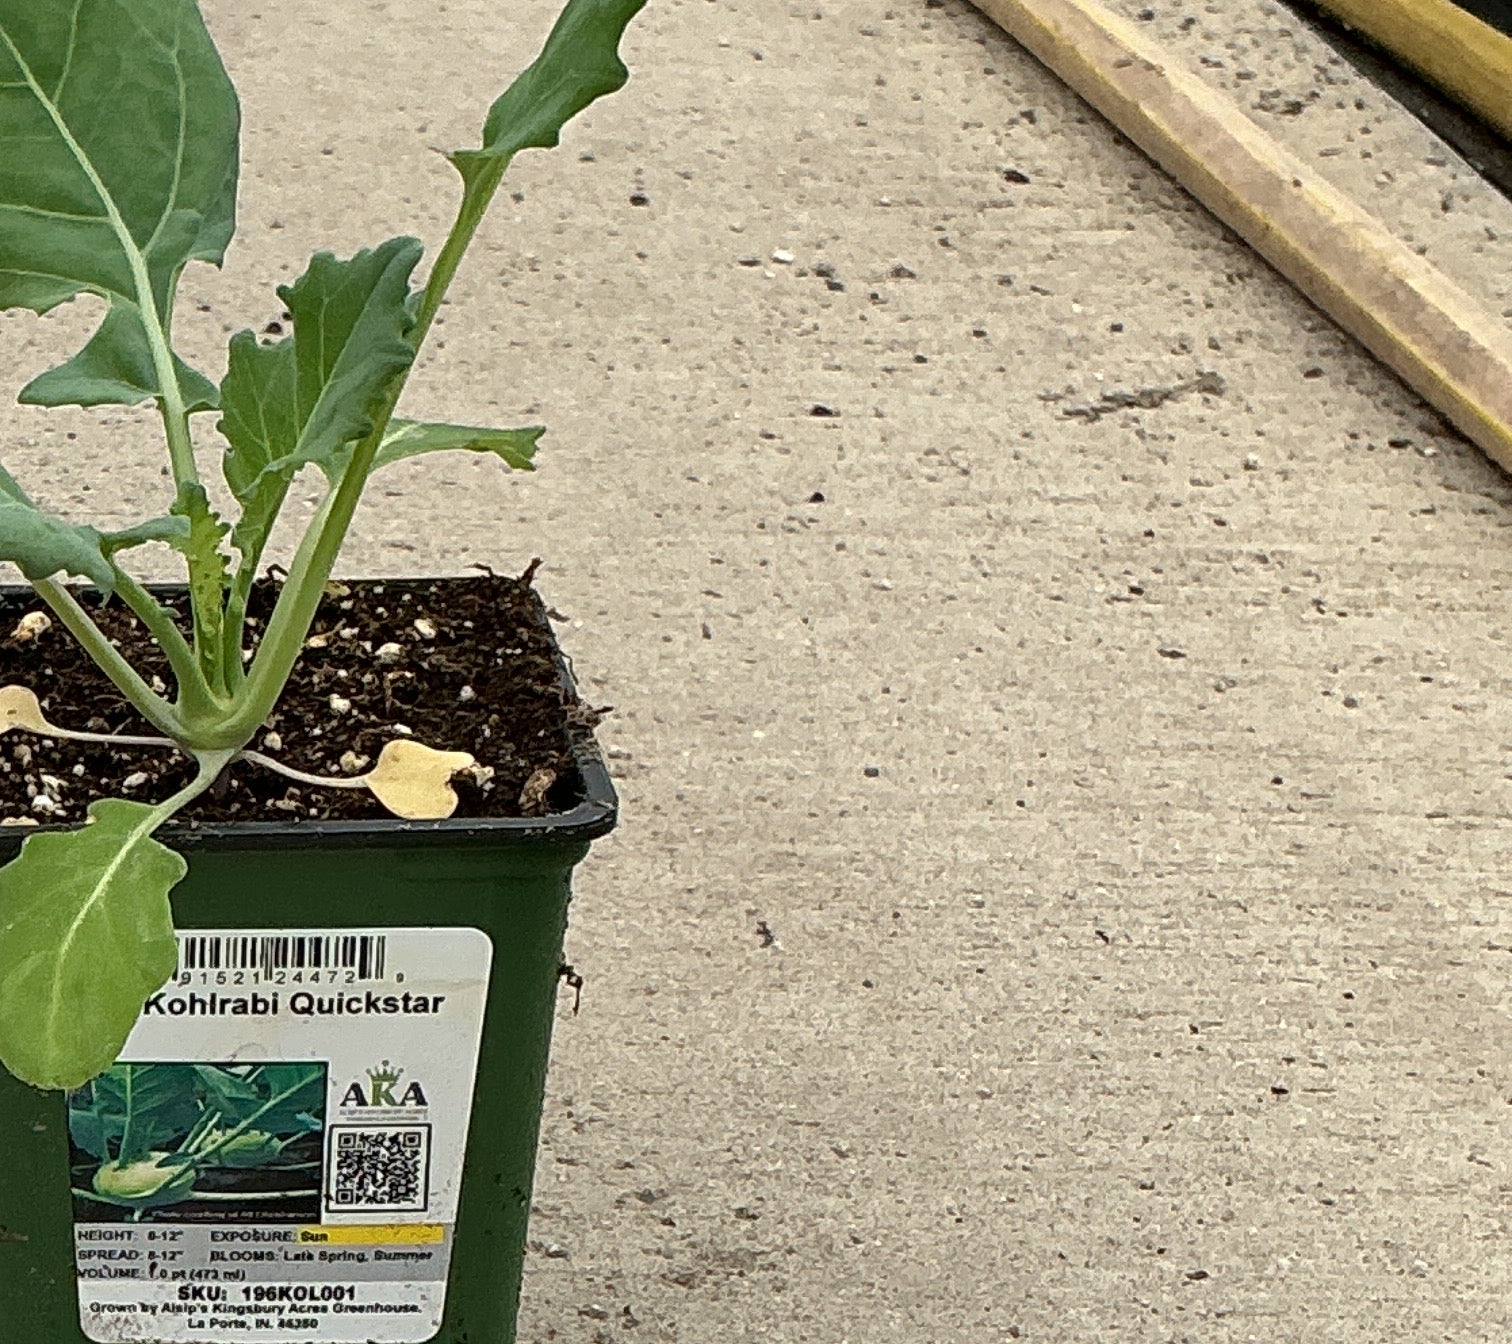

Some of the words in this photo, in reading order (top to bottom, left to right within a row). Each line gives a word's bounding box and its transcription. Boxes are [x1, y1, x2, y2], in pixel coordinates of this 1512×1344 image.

[144, 991, 279, 1016] Kohlrabi
[290, 990, 446, 1016] Quickstar
[339, 1074, 428, 1107] AKA
[77, 1229, 138, 1242] HEIGHT:
[210, 1229, 297, 1242] EXPOSURE:
[300, 1230, 328, 1242] Sun
[77, 1249, 143, 1261] SPREAD:
[209, 1249, 279, 1263] BLOOMS:
[284, 1249, 314, 1262] Late
[373, 1250, 434, 1262] Summer
[77, 1267, 144, 1279] VOLUME:
[171, 1268, 187, 1281] pt
[177, 1285, 227, 1302] SKU:
[241, 1285, 356, 1302] 196KOL001
[89, 1302, 137, 1313] Grown
[138, 1302, 158, 1316] by
[212, 1302, 285, 1316] Kingsbury
[287, 1303, 329, 1314] Acres
[187, 1318, 206, 1329] La
